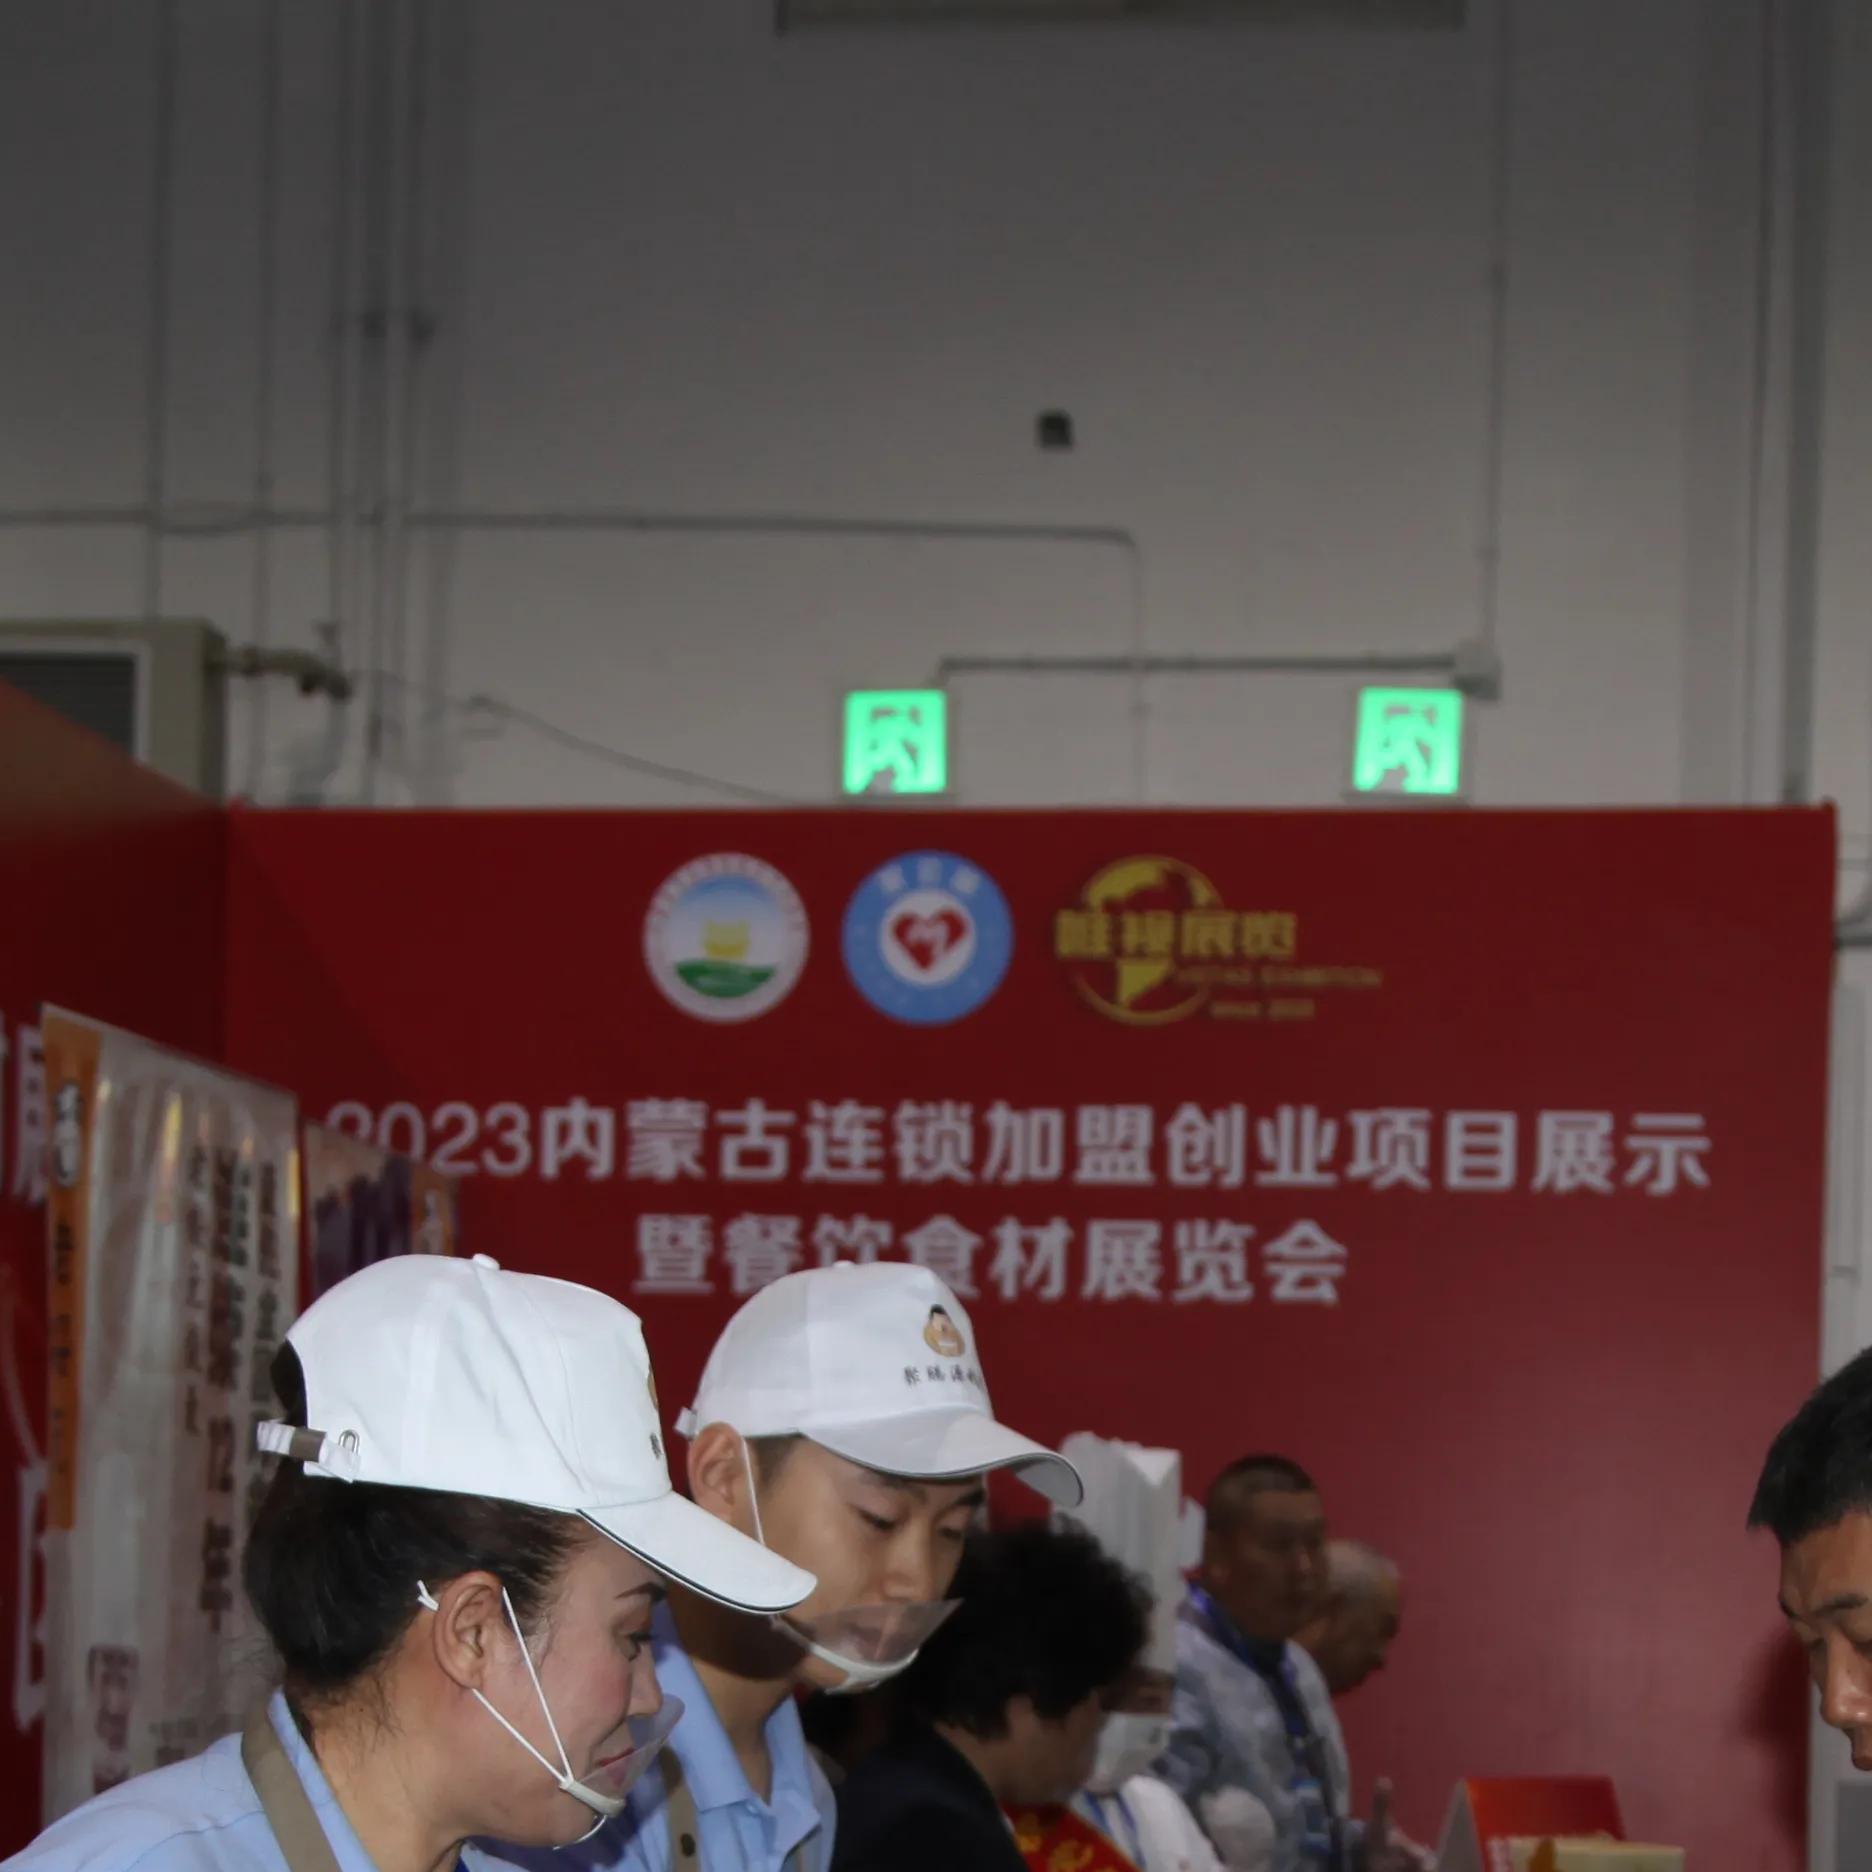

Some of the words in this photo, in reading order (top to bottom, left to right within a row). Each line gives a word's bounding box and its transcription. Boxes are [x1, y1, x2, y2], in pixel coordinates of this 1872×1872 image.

[631, 1212, 1348, 1306] 暨餐饮食材展览会
